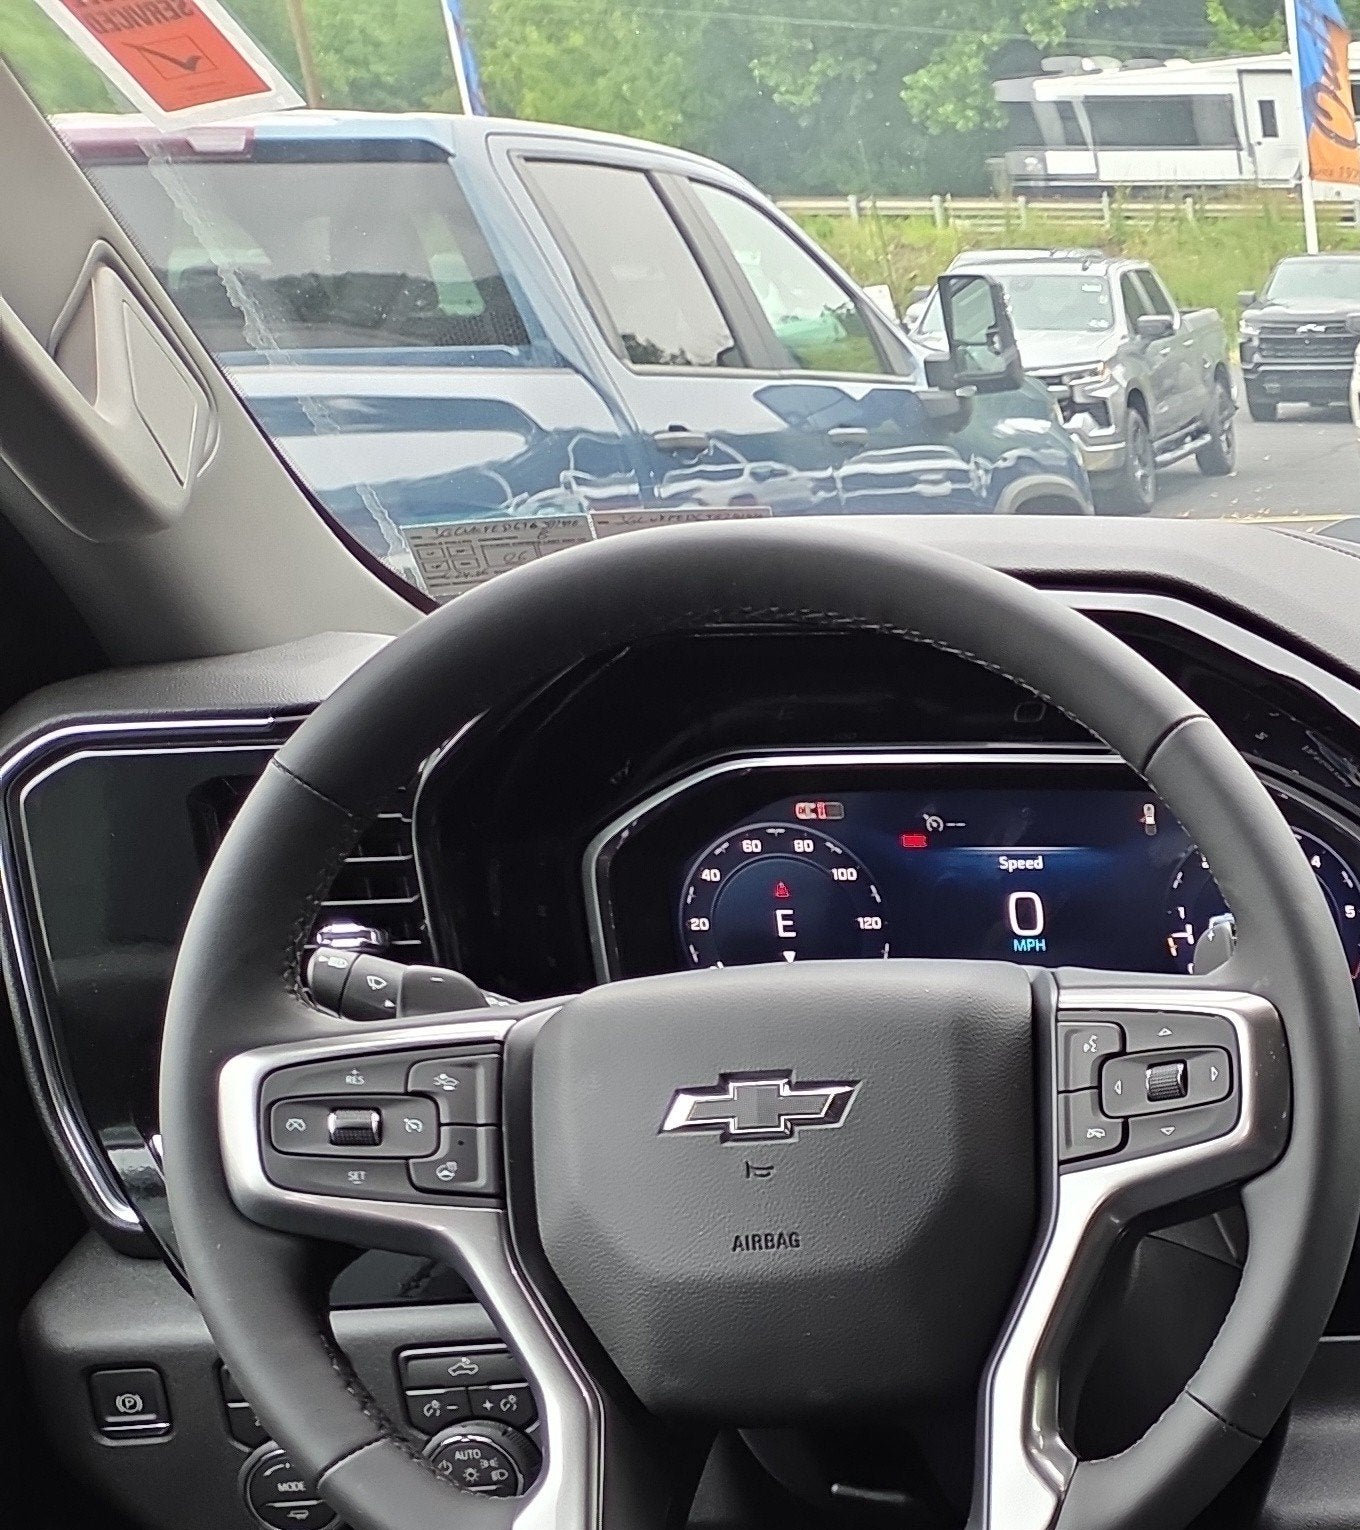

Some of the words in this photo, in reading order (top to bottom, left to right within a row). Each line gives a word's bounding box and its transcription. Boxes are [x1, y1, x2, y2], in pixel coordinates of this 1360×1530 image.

[742, 839, 762, 853] 60
[794, 839, 814, 853] 80
[998, 857, 1044, 873] Speed
[1310, 855, 1321, 869] 4
[700, 868, 721, 882] 40
[831, 868, 858, 881] 100
[1008, 891, 1044, 936] 0
[1345, 904, 1355, 918] 5
[689, 917, 710, 931] 20
[775, 909, 797, 938] E
[857, 916, 882, 930] 120
[1013, 938, 1046, 952] MPH
[347, 1170, 367, 1182] SET
[731, 1231, 801, 1253] AIRBAG
[454, 1448, 482, 1462] AUTO
[276, 1480, 307, 1493] MODE
